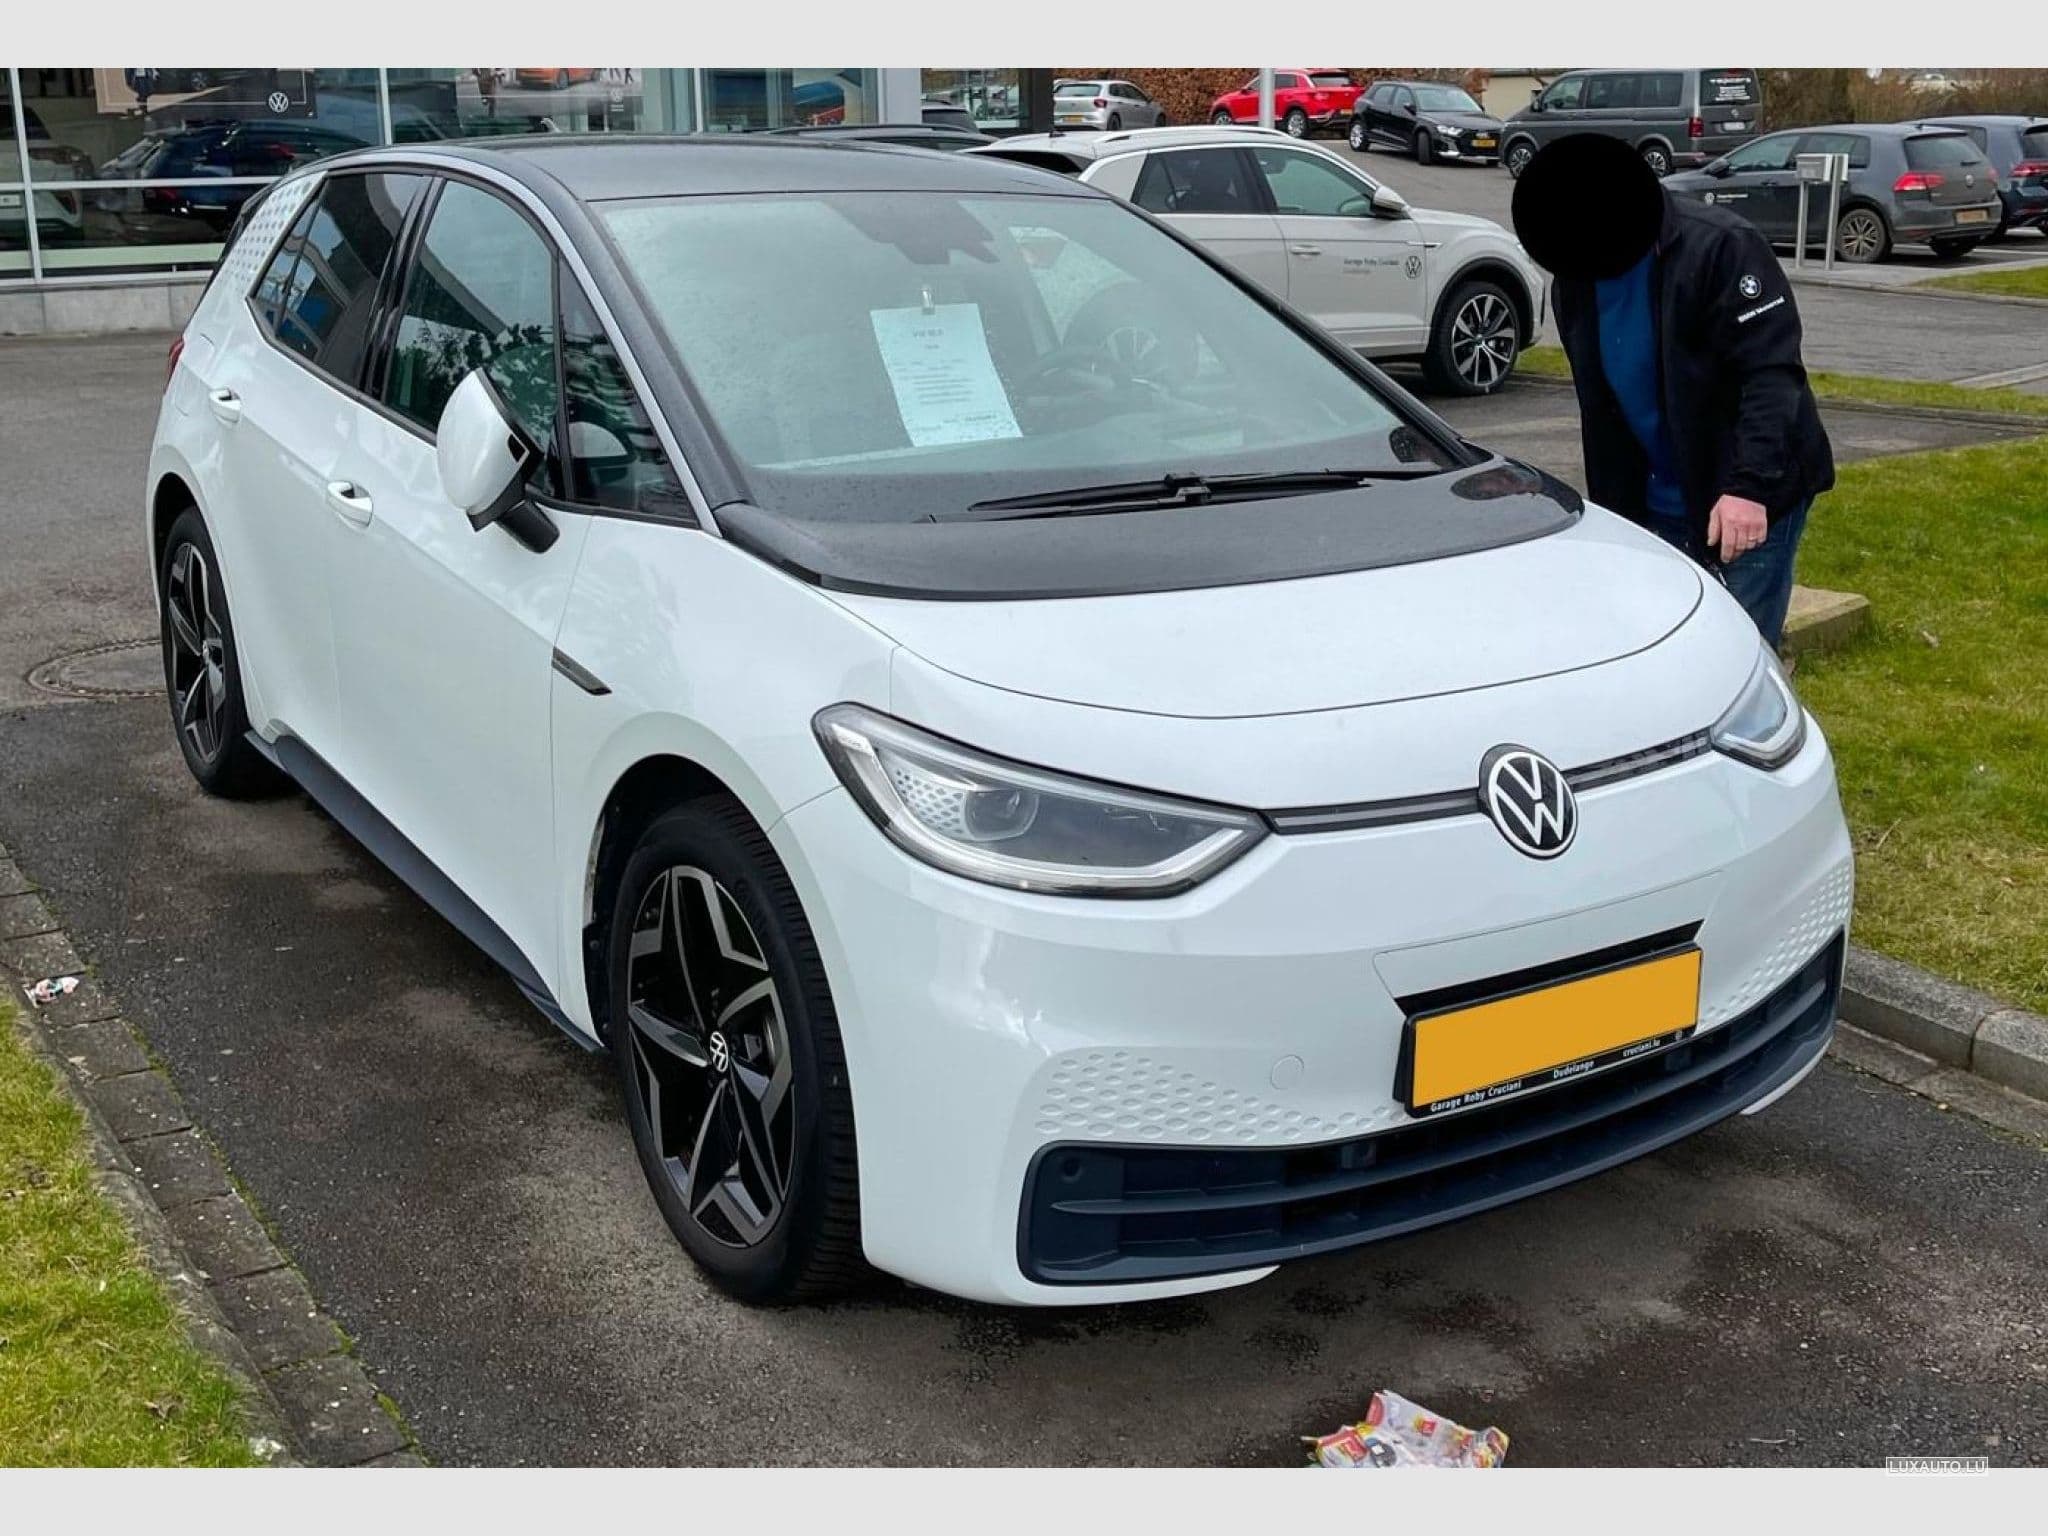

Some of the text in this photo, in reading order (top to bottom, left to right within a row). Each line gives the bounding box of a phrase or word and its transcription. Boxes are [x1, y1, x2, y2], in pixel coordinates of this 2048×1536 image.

[1489, 750, 1576, 857] VW
[1552, 1060, 1595, 1079] Dudelange
[1430, 1079, 1523, 1113] Garage Roby Cruciani
